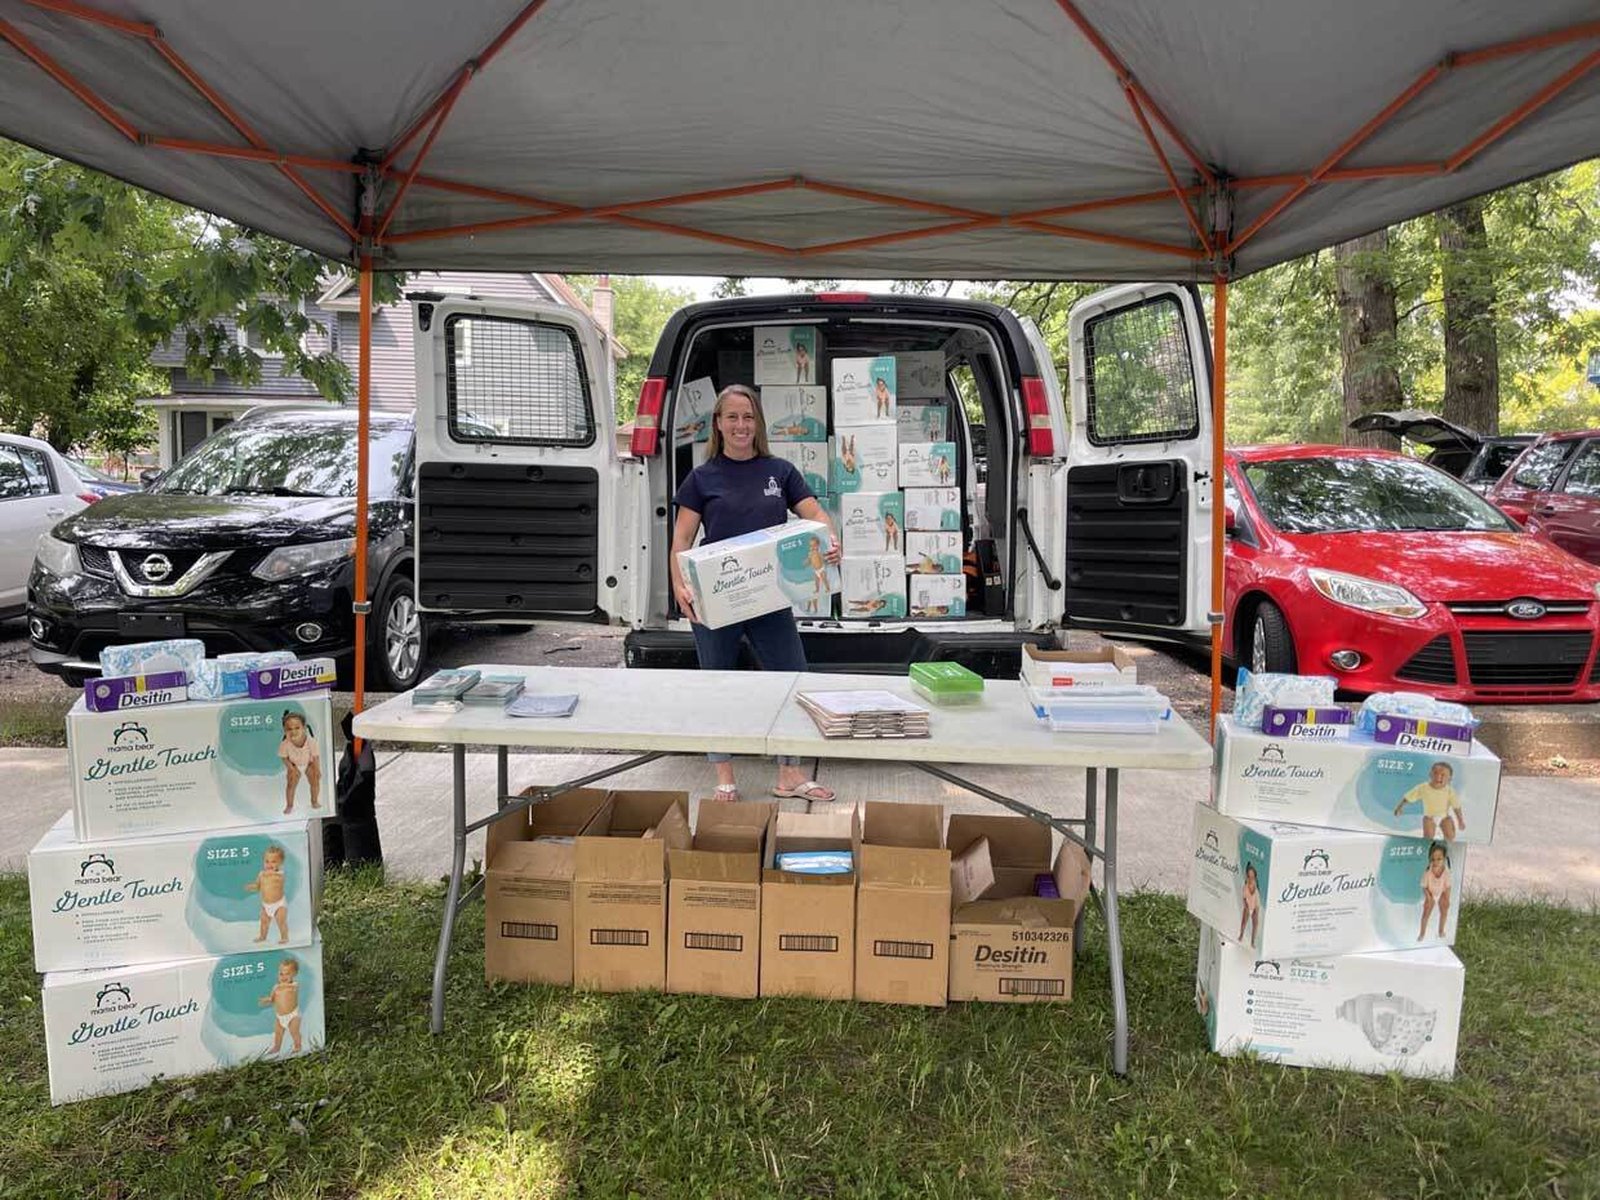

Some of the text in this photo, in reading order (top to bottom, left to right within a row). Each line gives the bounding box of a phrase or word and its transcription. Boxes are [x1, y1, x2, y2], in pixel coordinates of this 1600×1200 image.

[712, 575, 746, 595] Gentle
[745, 563, 775, 579] Touch
[281, 664, 324, 682] Desitin
[121, 690, 172, 707] Desitin
[230, 714, 273, 727] SIZE 6
[1291, 724, 1336, 738] Desitin
[107, 743, 155, 753] mama bear
[1399, 734, 1453, 753] Desitin
[84, 745, 217, 781] Gentle Touch
[1377, 759, 1415, 771] SIZE 7
[1241, 764, 1325, 779] Gentle Touch
[206, 847, 250, 860] SIZE 5
[1389, 846, 1424, 857] SIZE 6
[74, 874, 122, 885] mama bear
[52, 877, 183, 914] Gentle Touch
[1278, 873, 1377, 904] Gentle Touch
[1011, 930, 1070, 942] 510342326
[974, 944, 1048, 964] Desitin
[222, 962, 265, 979] SIZE 5
[1290, 968, 1329, 980] SIZE 6
[90, 1002, 138, 1015] mama bear
[67, 999, 200, 1046] Gentle Touch
